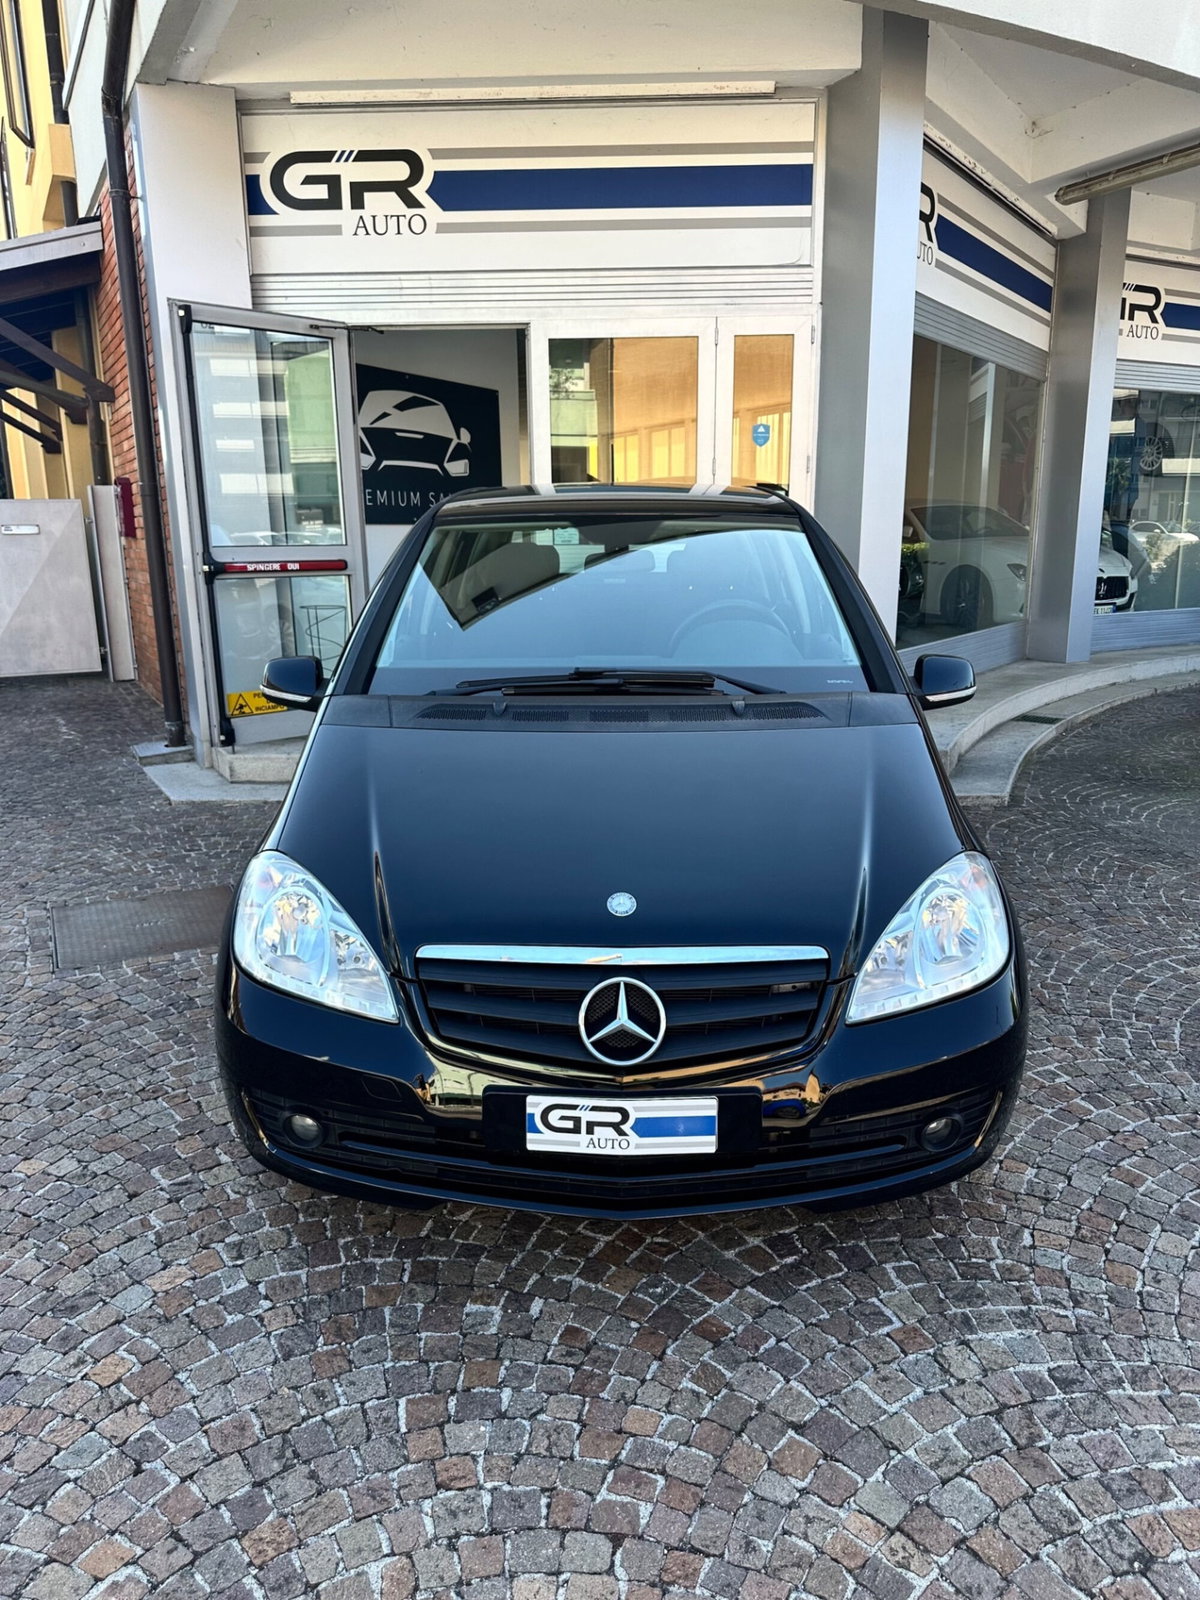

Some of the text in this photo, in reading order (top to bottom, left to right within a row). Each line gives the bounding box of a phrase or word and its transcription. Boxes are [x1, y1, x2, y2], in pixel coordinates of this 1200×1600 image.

[270, 149, 426, 211] GR
[352, 213, 427, 236] AUTO
[1120, 282, 1161, 324] R
[1126, 324, 1159, 340] AUTO
[247, 563, 281, 571] SPINGERE
[540, 1103, 630, 1136] GR
[586, 1137, 630, 1150] AUTO
